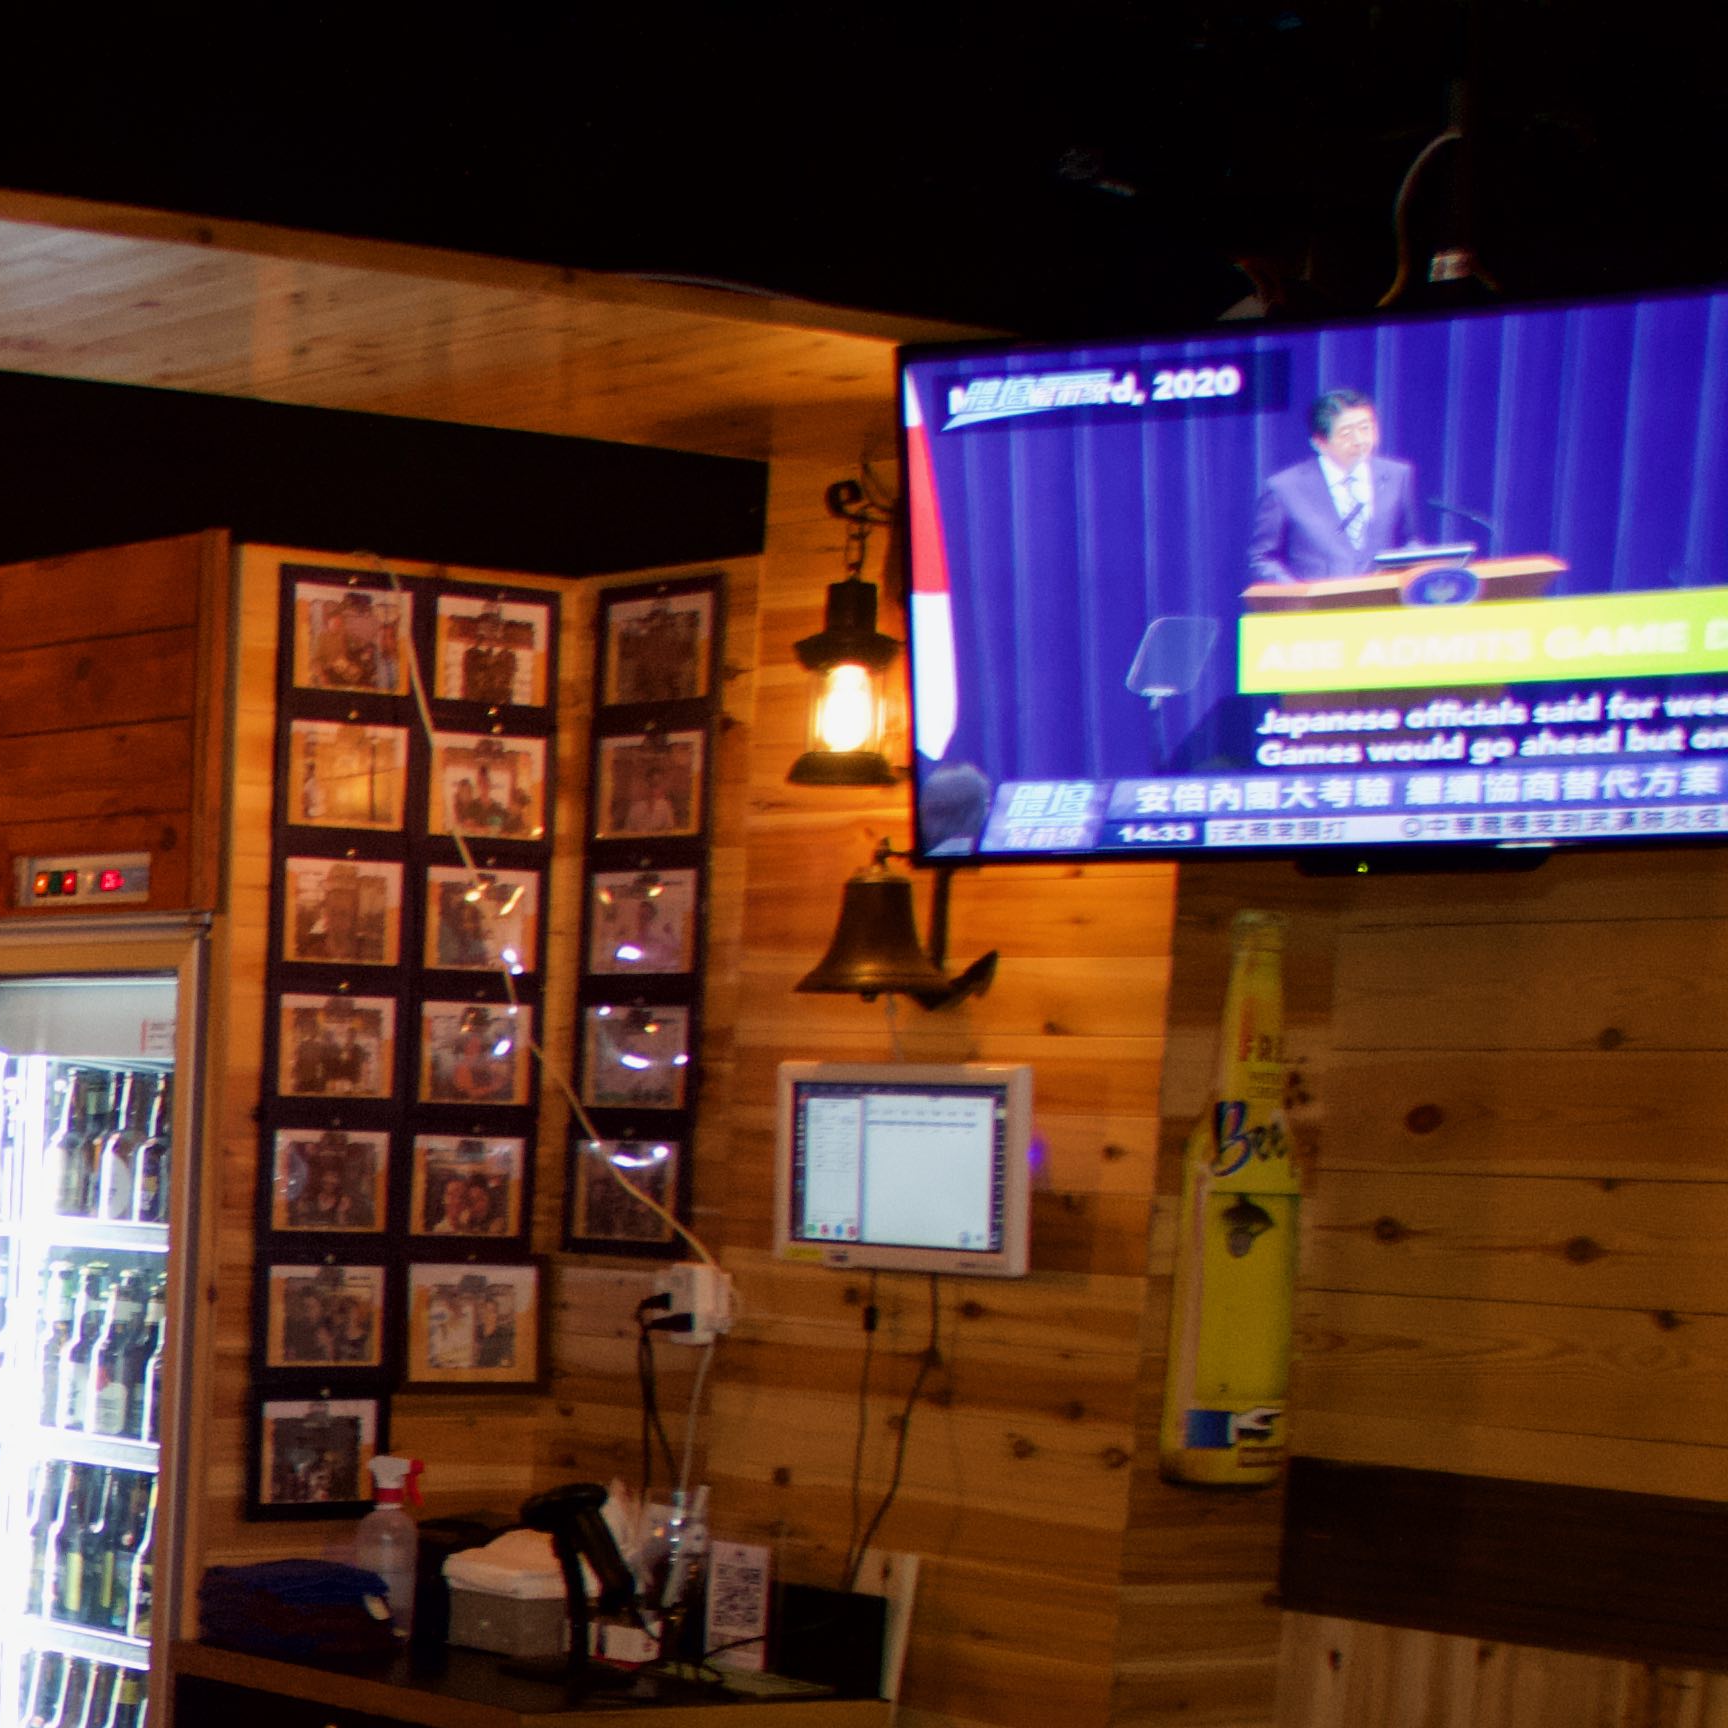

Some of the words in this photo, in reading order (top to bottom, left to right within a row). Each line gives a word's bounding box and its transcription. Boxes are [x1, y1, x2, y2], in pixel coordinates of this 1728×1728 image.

[1152, 365, 1244, 402] 2020
[1544, 620, 1689, 659] GAME
[1255, 708, 1401, 740] Japanese
[1405, 698, 1529, 730] officials
[1532, 693, 1600, 724] said
[1606, 689, 1661, 720] for
[1255, 737, 1363, 767] Games
[1366, 732, 1465, 762] would
[1469, 736, 1516, 765] go
[1518, 728, 1621, 758] ahead
[1624, 724, 1686, 752] but
[1117, 824, 1195, 844] 14:33
